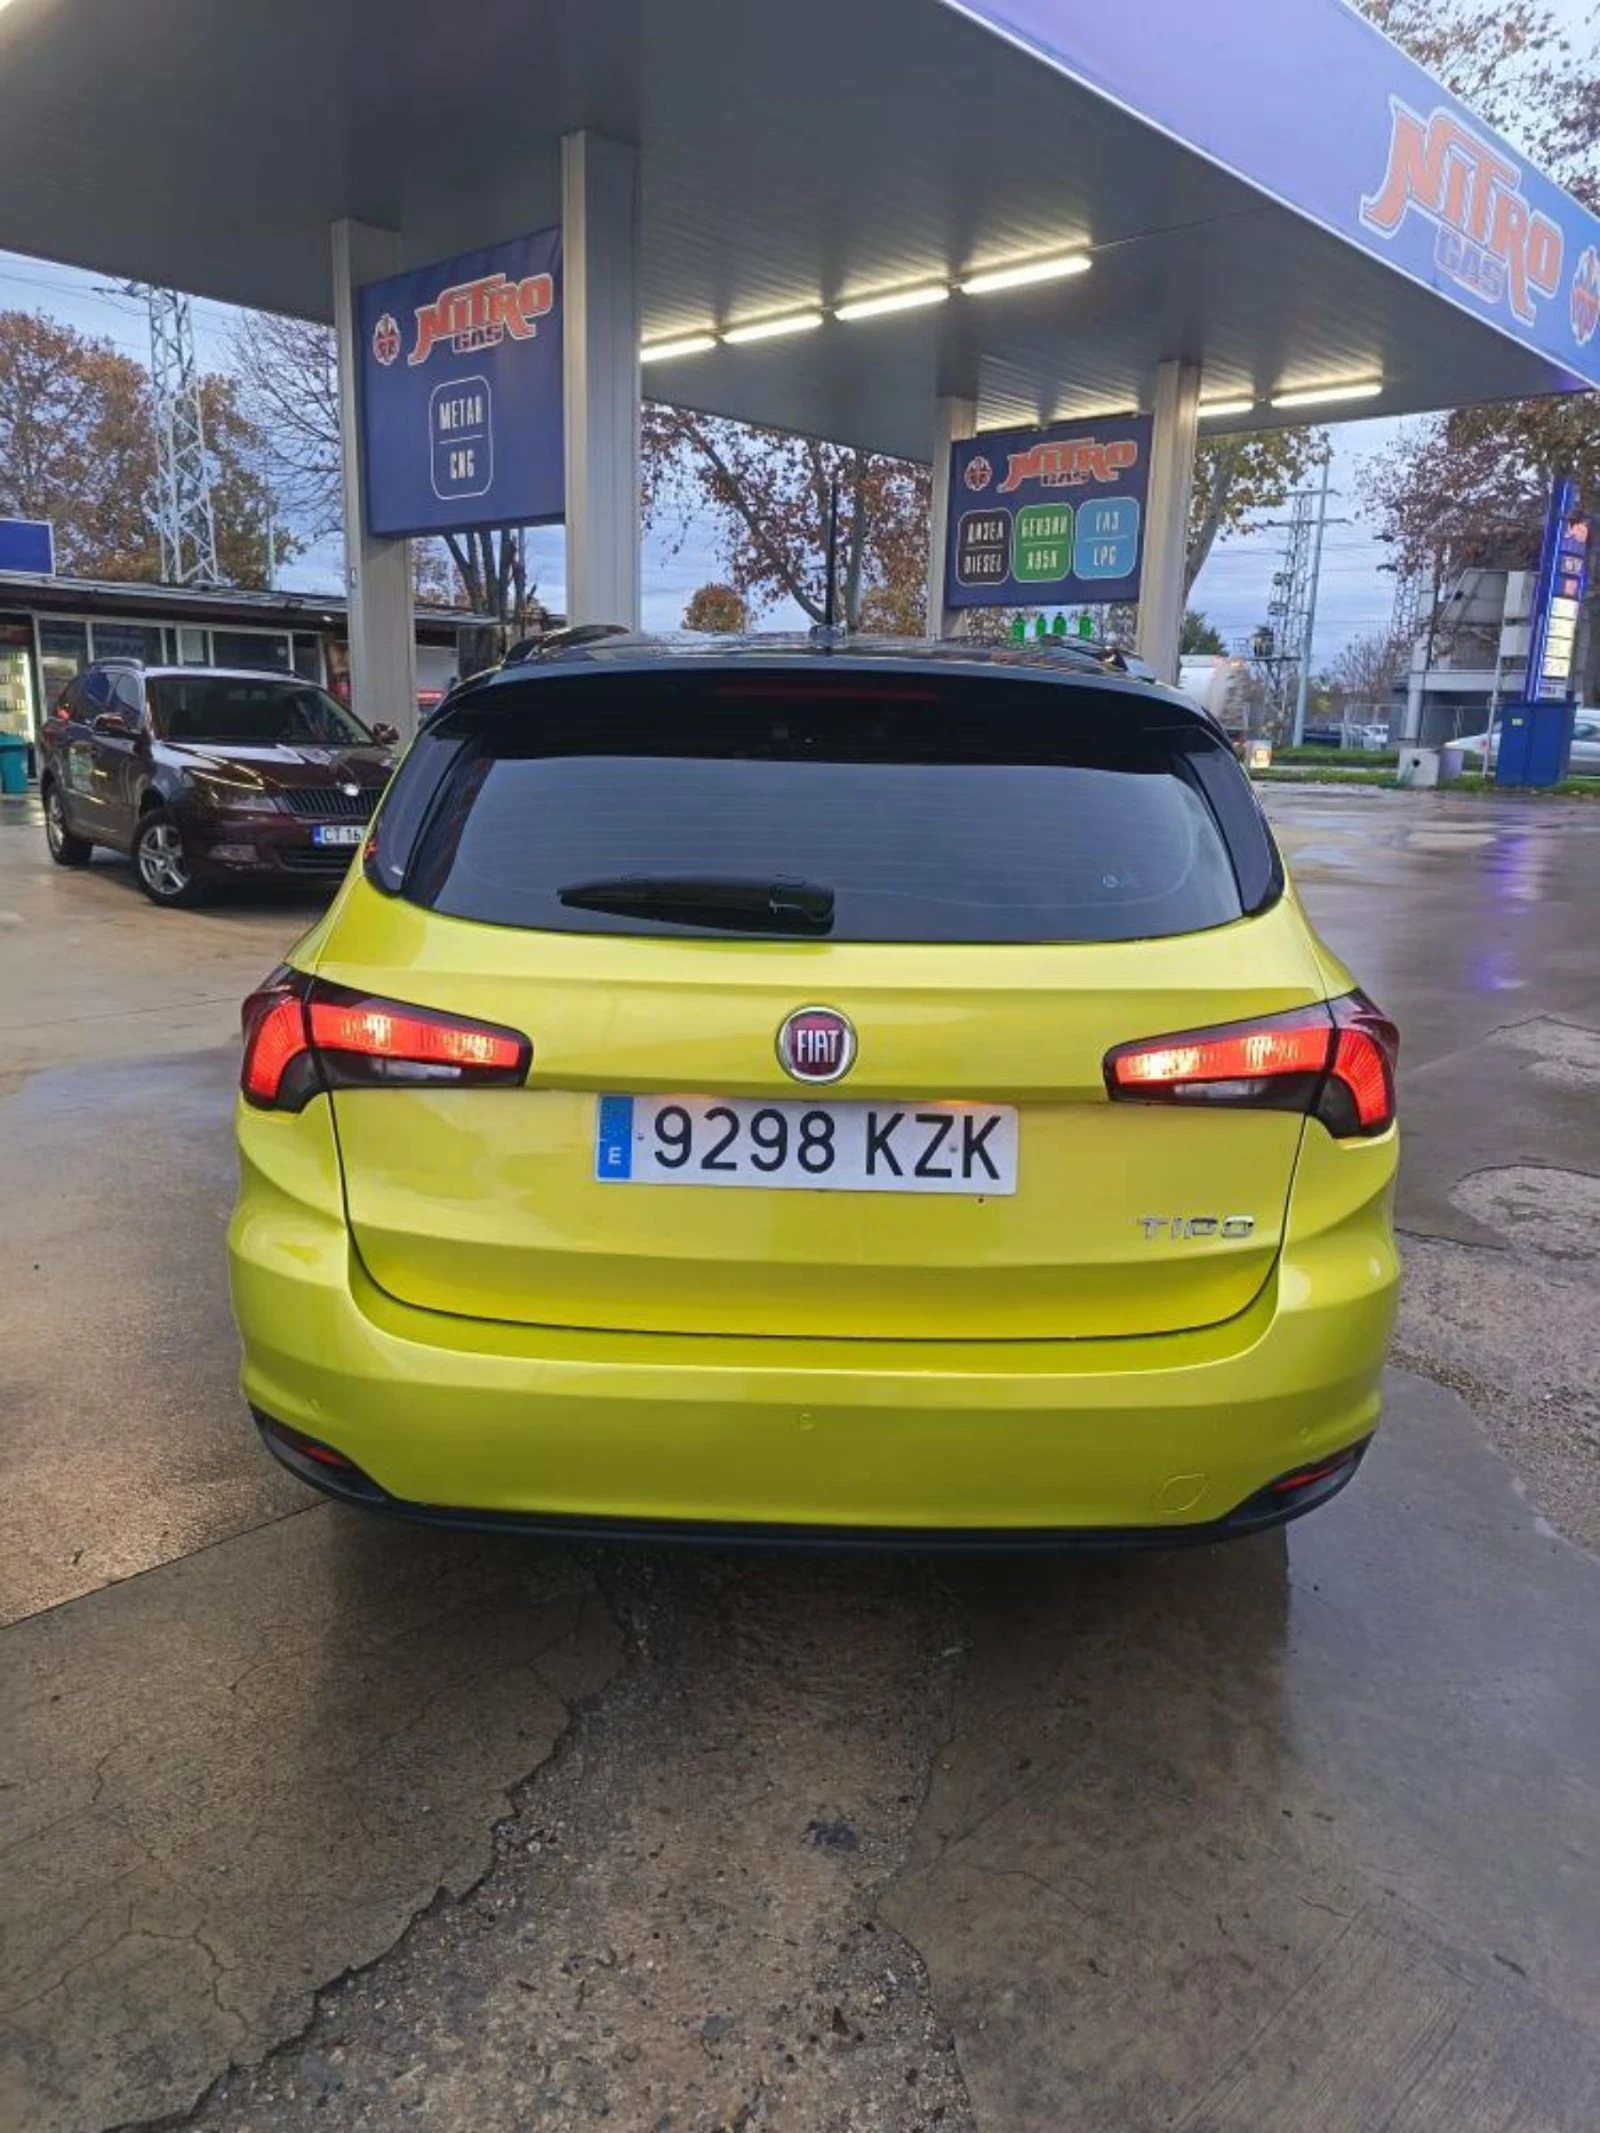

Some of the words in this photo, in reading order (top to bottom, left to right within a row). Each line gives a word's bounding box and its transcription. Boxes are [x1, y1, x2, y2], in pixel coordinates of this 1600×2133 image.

[1435, 222, 1507, 303] GAS
[453, 324, 504, 352] GAS
[449, 449, 475, 479] CNG
[963, 553, 1002, 575] DIESEL
[1093, 545, 1117, 566] LPG
[796, 1029, 840, 1064] FIAT
[607, 1146, 623, 1165] E
[653, 1105, 836, 1174] 9298
[865, 1111, 1002, 1181] KZK
[1137, 1214, 1256, 1240] TIPO
